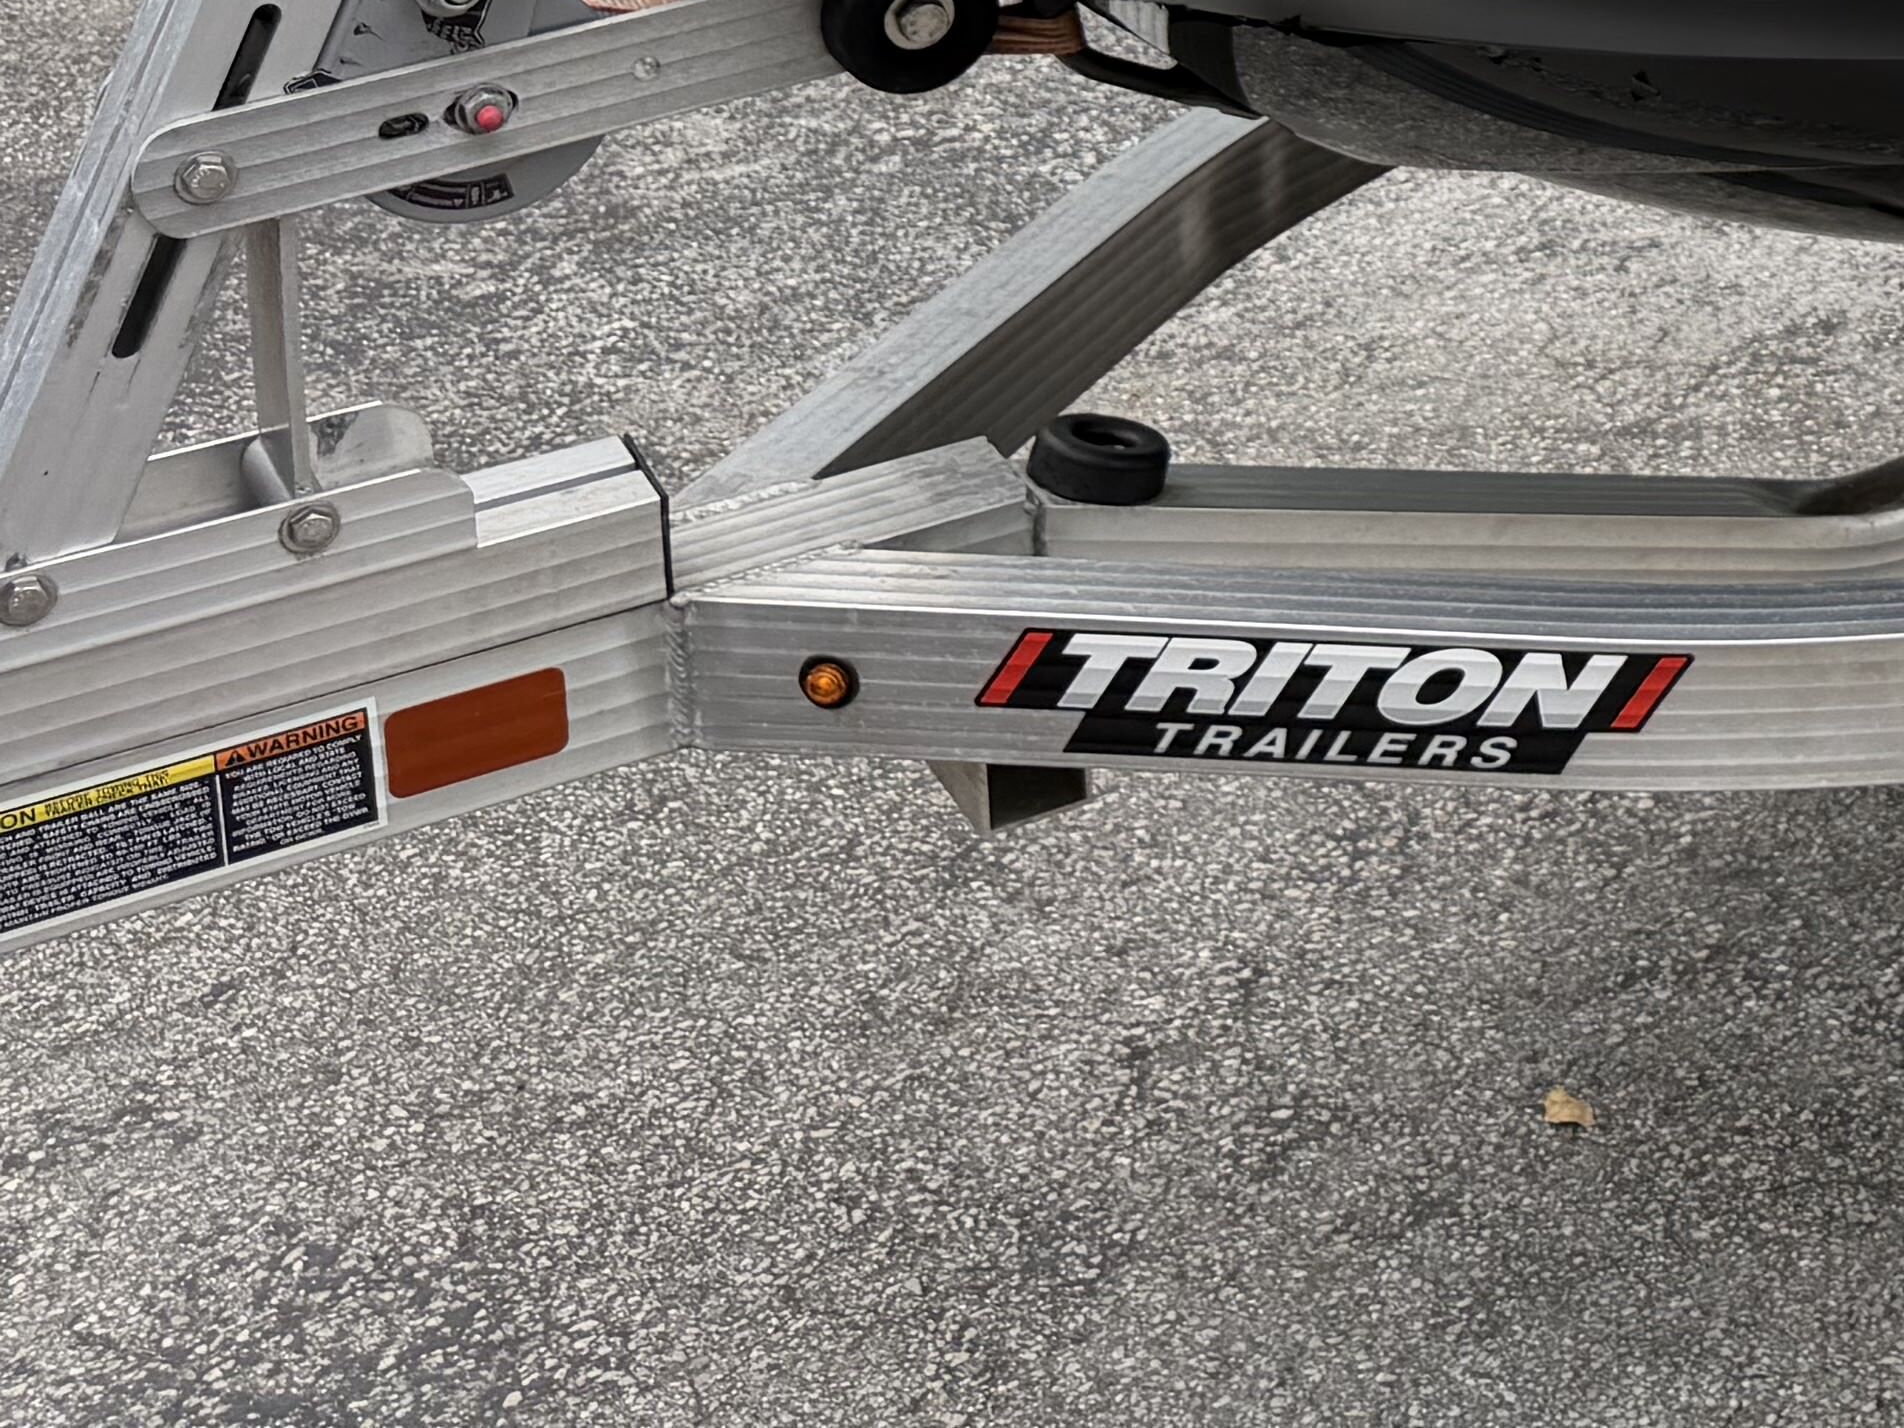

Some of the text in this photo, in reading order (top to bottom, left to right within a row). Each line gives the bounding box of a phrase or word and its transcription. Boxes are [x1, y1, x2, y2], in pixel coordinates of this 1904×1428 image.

[1055, 631, 1629, 729] TRITON
[247, 716, 358, 759] WARNING
[1152, 722, 1520, 771] TRAILERS
